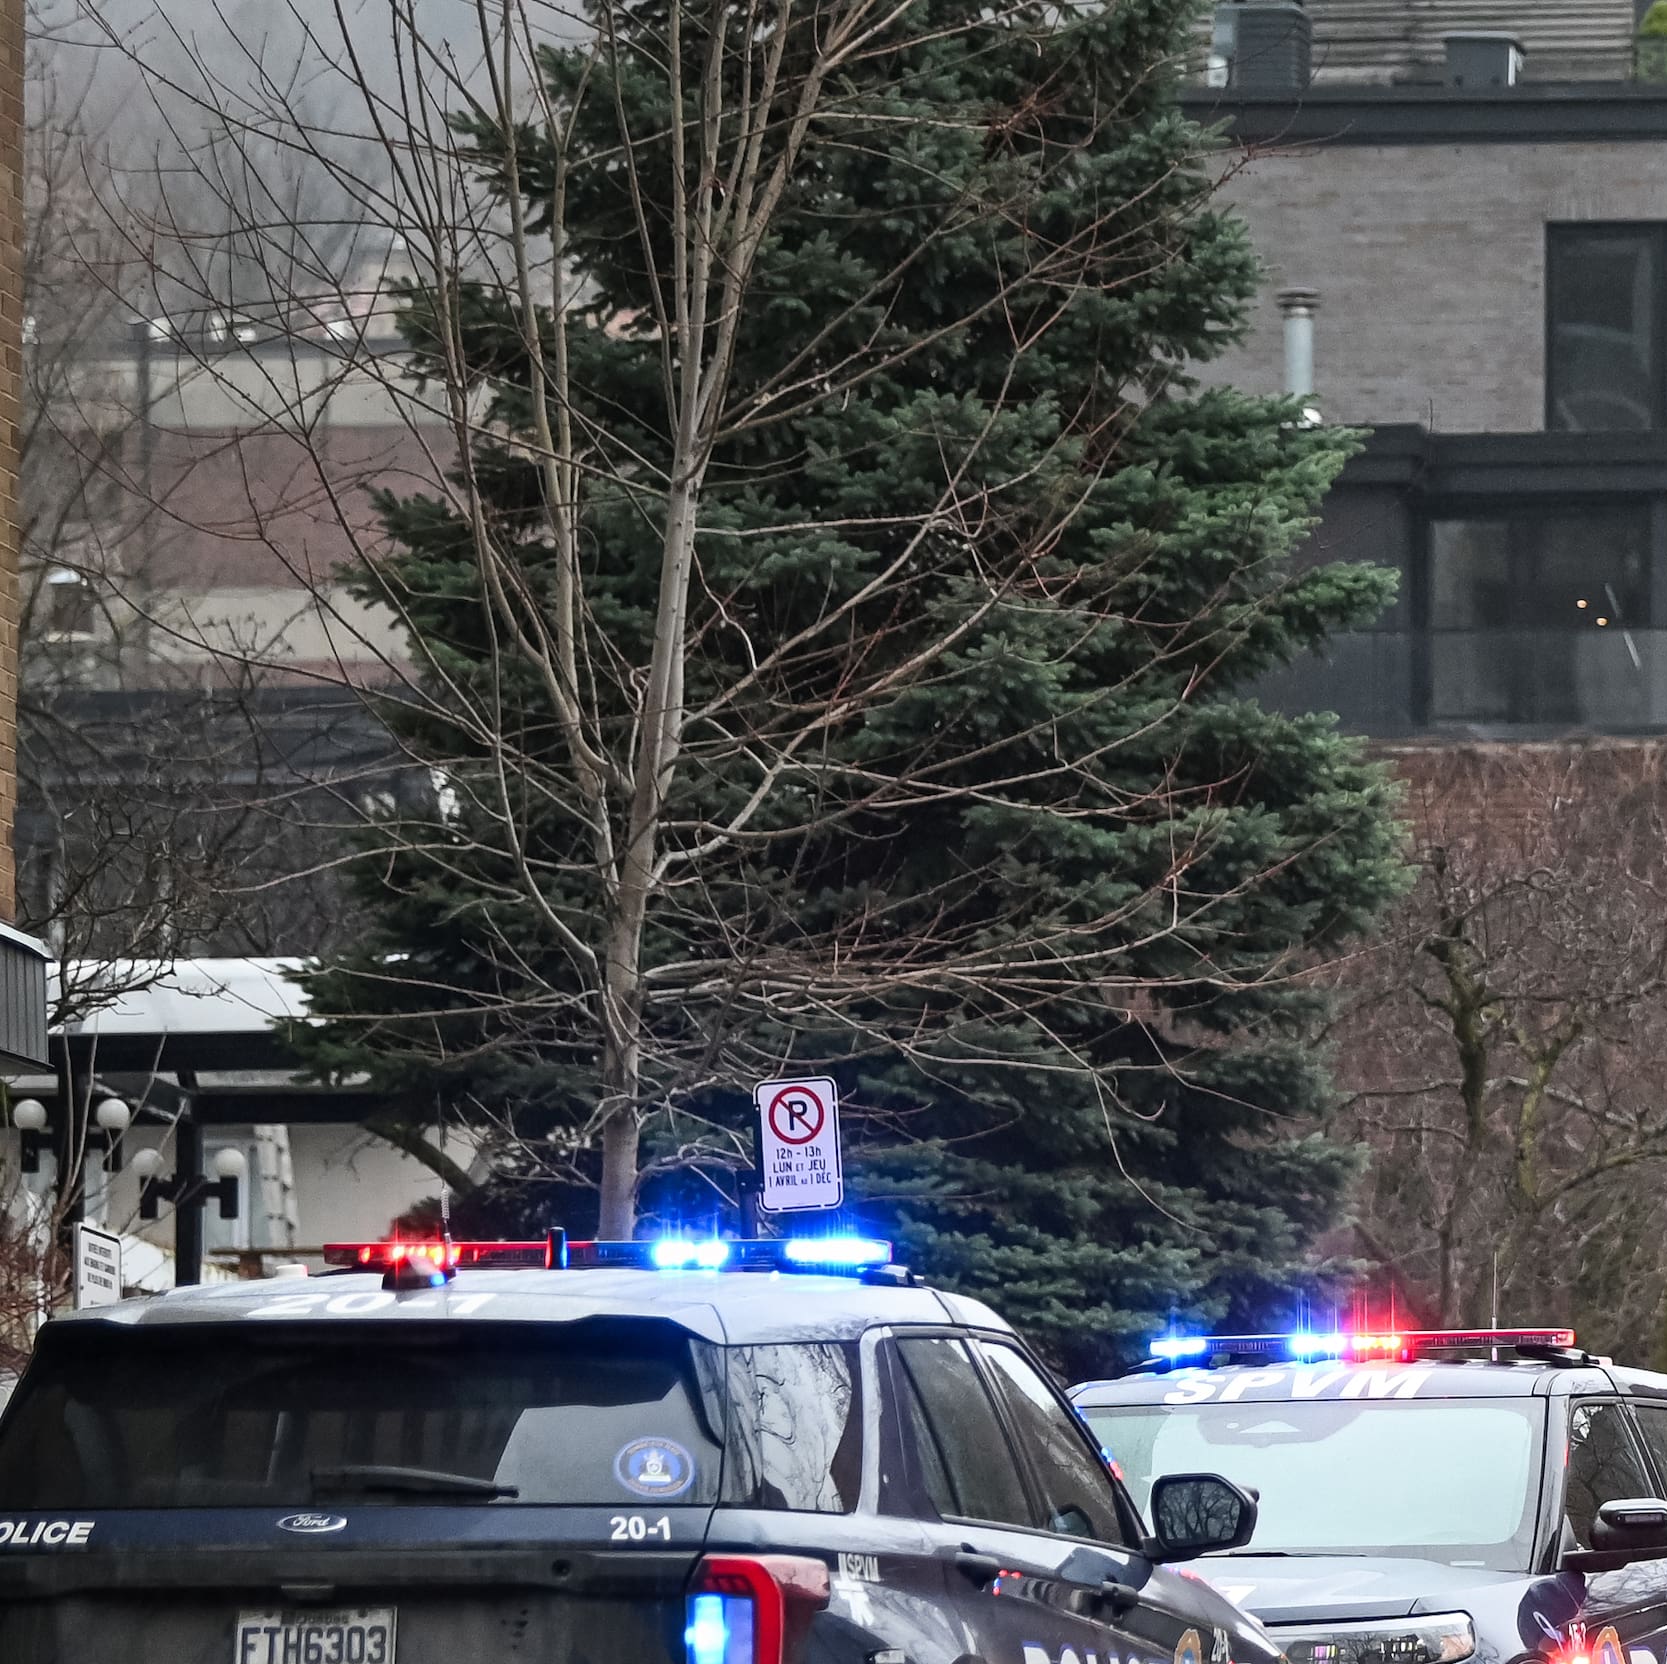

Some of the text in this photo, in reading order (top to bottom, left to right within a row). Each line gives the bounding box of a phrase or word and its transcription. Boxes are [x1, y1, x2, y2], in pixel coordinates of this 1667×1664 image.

[788, 1100, 808, 1131] P
[776, 1148, 793, 1161] 12h
[805, 1146, 821, 1158] 13h
[773, 1159, 826, 1174] LUN ET JEU
[775, 1174, 798, 1187] AVRIL
[816, 1171, 831, 1184] DÉC
[246, 1292, 497, 1317] 20-1
[1163, 1369, 1434, 1405] SPVM
[0, 1521, 96, 1545] OLICE
[291, 1515, 331, 1528] Ford
[610, 1516, 672, 1540] 20-1
[846, 1553, 881, 1582] SPVM
